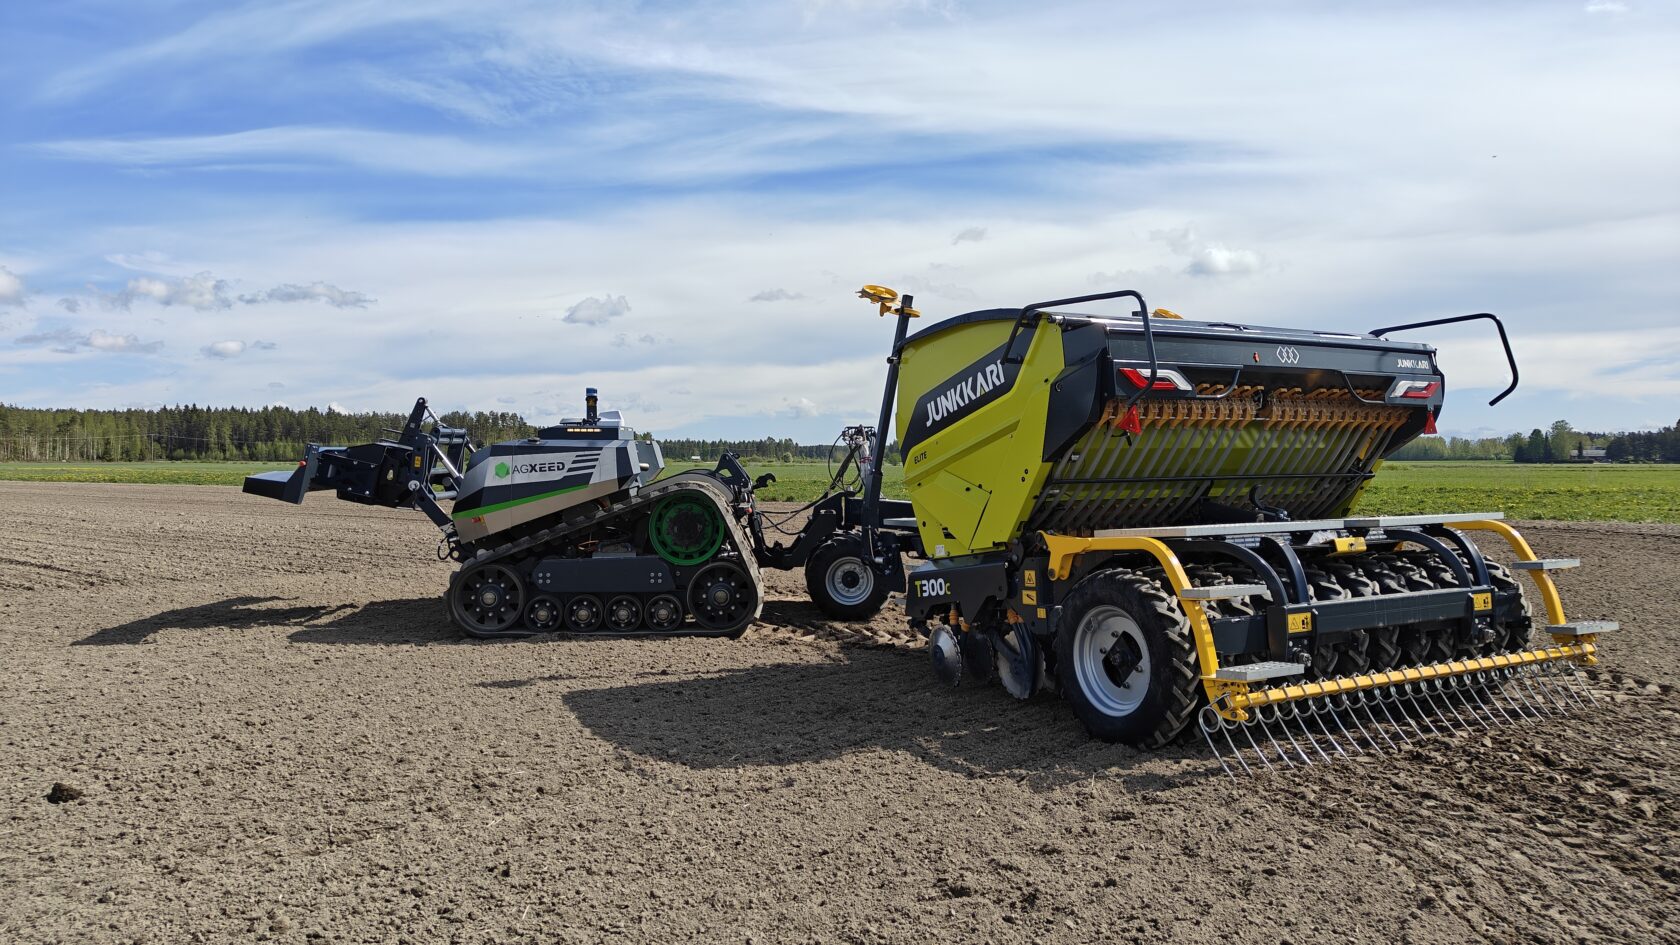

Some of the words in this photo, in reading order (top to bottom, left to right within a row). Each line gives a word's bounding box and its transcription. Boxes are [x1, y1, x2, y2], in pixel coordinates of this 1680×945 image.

[926, 360, 1005, 428] JUNKKARI
[914, 451, 927, 464] ELITE
[512, 462, 565, 475] AGXEED
